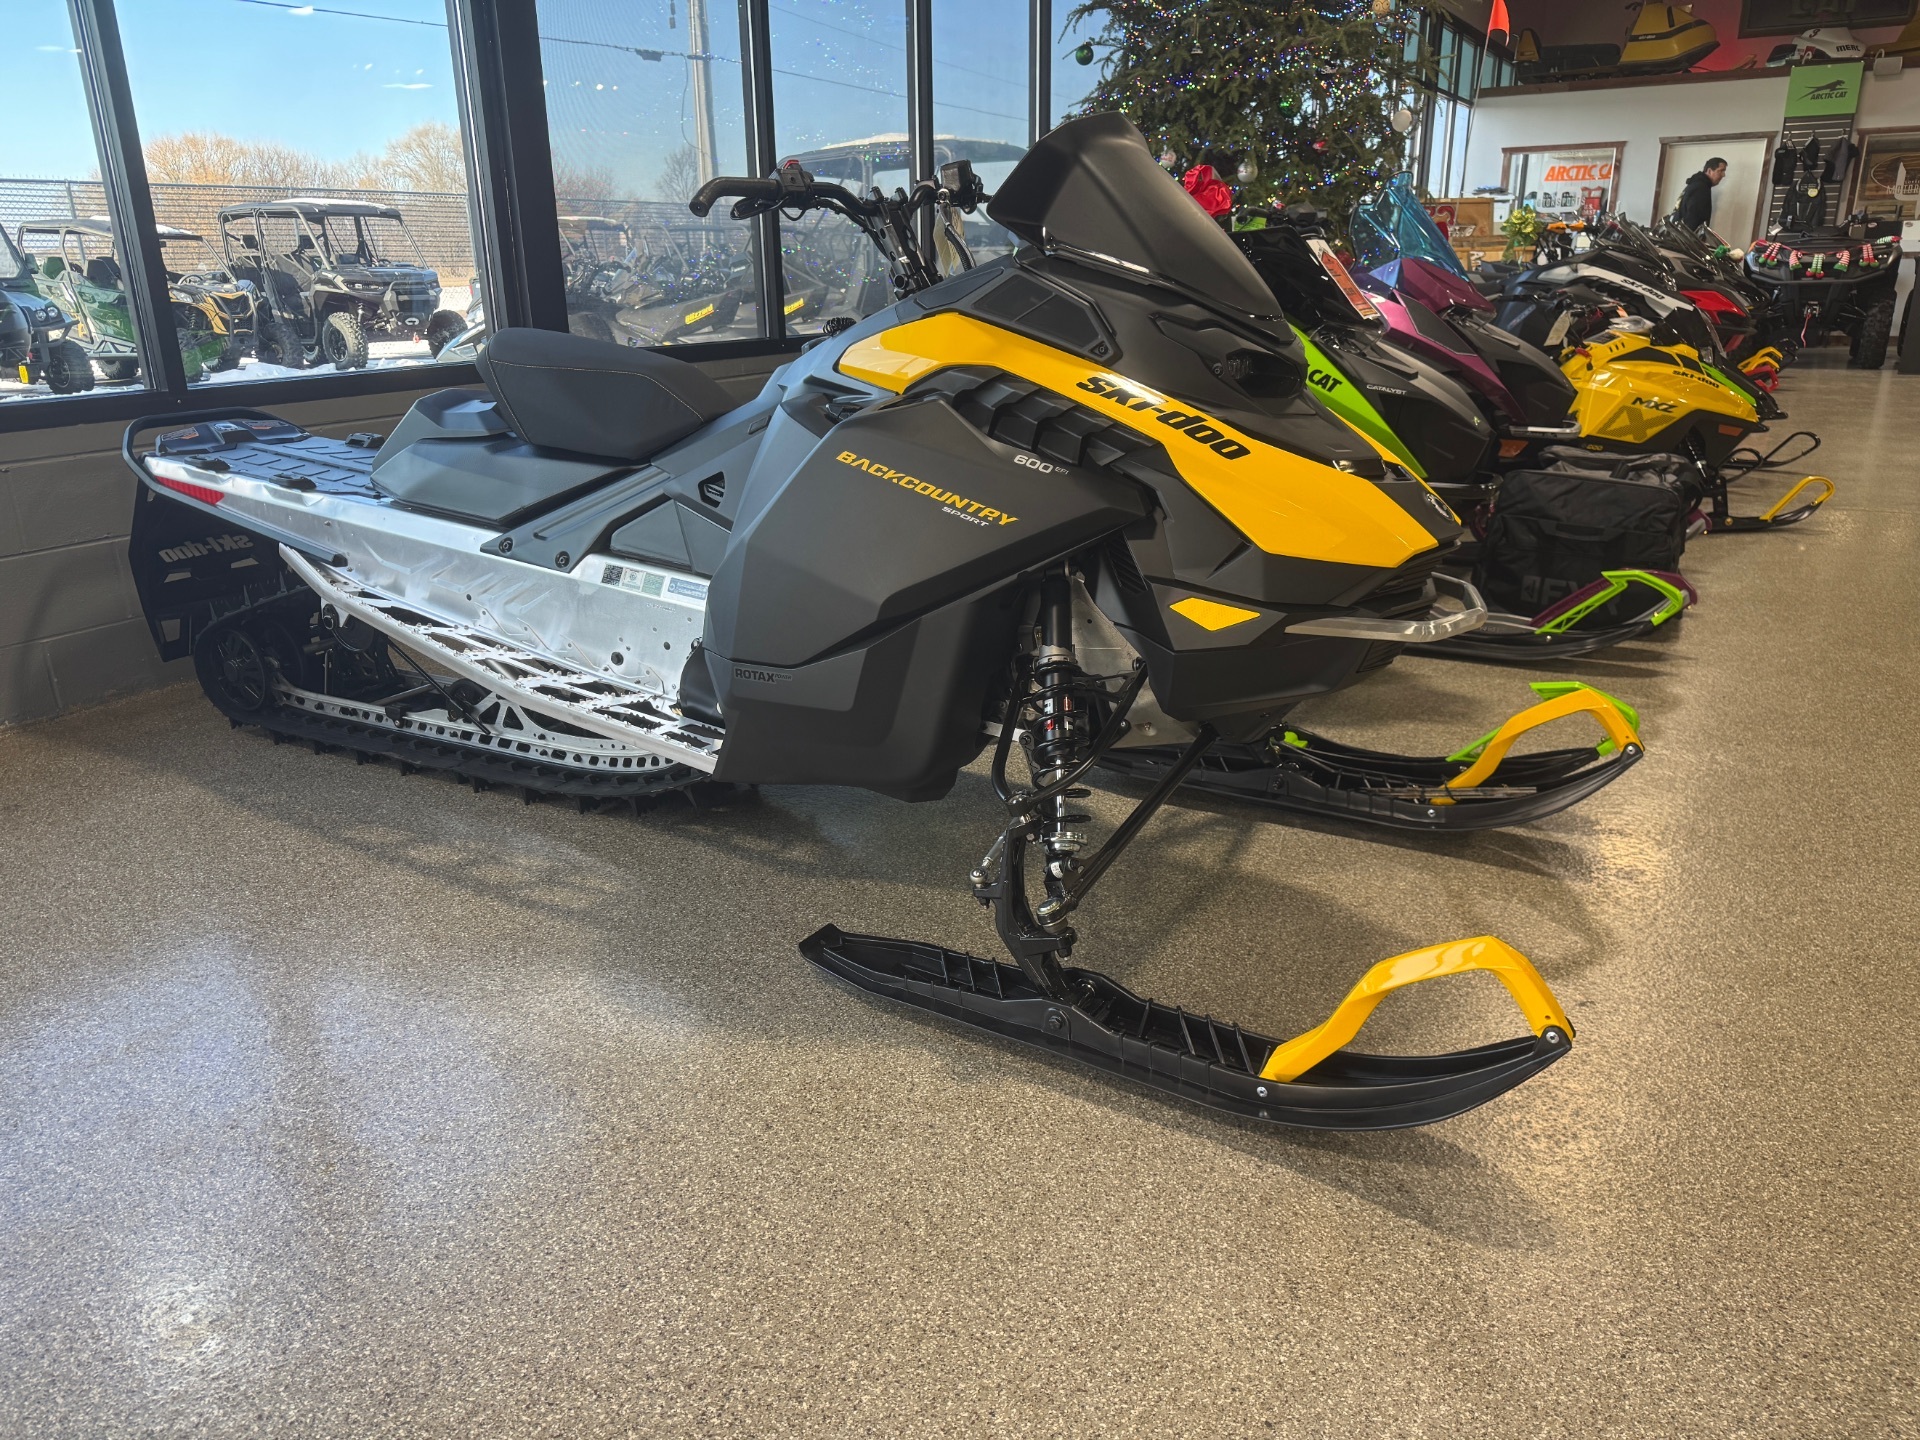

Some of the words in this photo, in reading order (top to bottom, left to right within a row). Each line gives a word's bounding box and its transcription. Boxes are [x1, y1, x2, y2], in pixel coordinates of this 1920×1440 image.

[1810, 92, 1834, 100] ARCTIC
[1834, 91, 1848, 99] CAT
[1544, 165, 1598, 181] ARCTIC
[1308, 369, 1343, 393] CAT
[1366, 384, 1408, 396] CATALYST
[1632, 397, 1678, 414] MXZ
[1014, 454, 1053, 474] 600
[836, 450, 1019, 526] BACKCOUNTRY
[941, 506, 990, 527] SPORT
[735, 668, 775, 683] ROTAX
